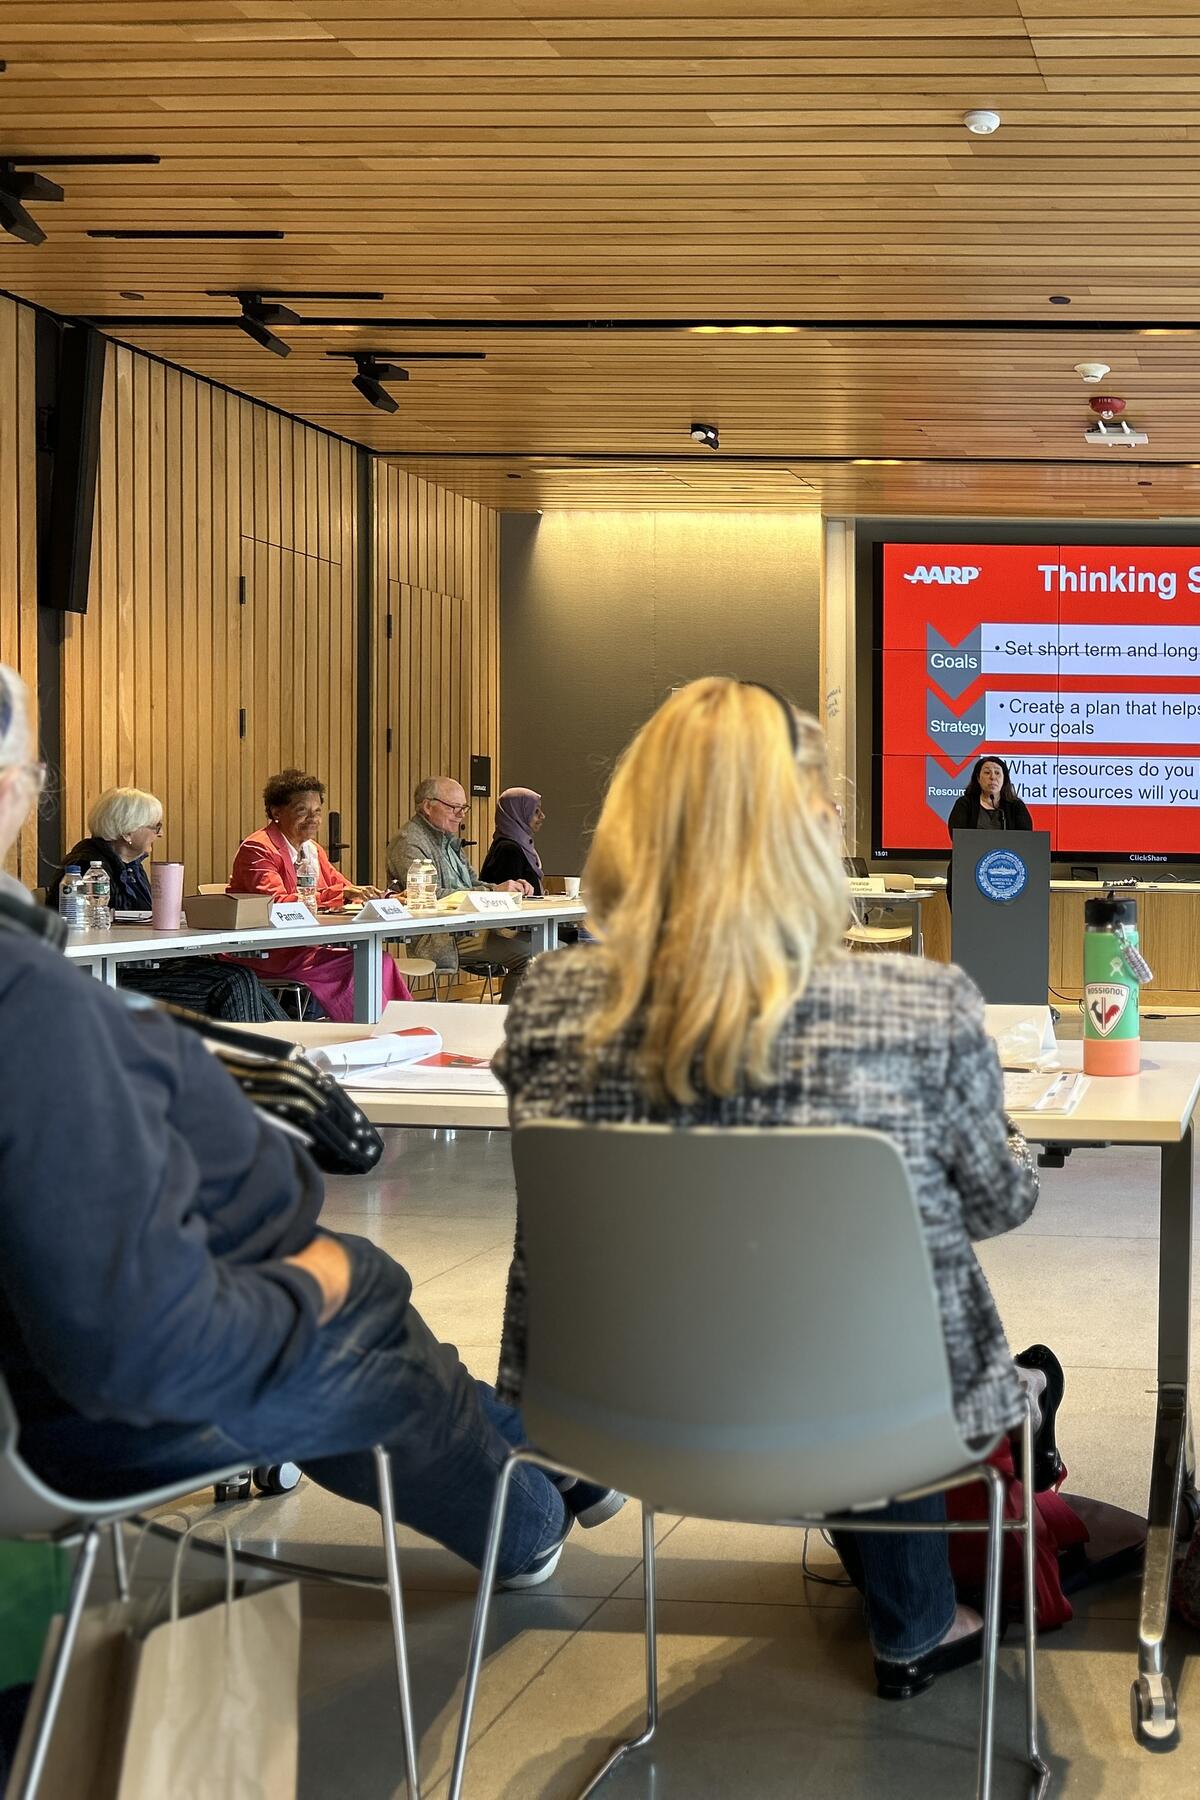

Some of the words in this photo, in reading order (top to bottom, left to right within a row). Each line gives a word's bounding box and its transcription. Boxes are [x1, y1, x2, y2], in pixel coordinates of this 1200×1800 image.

[903, 566, 980, 585] AARP
[1037, 564, 1177, 600] Thinking
[930, 652, 978, 669] Goals
[1005, 640, 1033, 656] Set
[1038, 641, 1080, 657] short
[1085, 642, 1121, 657] term
[1127, 642, 1158, 658] and
[1163, 642, 1198, 662] long
[1009, 698, 1065, 714] Create
[1070, 703, 1080, 714] a
[1086, 700, 1120, 718] plan
[1126, 701, 1157, 715] that
[930, 720, 985, 735] Strategy
[1009, 722, 1046, 737] your
[1050, 720, 1094, 738] goals
[1004, 760, 1048, 775] What
[1053, 764, 1134, 776] resources
[1139, 762, 1159, 777] do
[1165, 765, 1194, 780] you
[1053, 787, 1134, 799] resources
[1138, 785, 1164, 800] will
[1169, 788, 1199, 804] you
[1129, 854, 1168, 862] ClickShare
